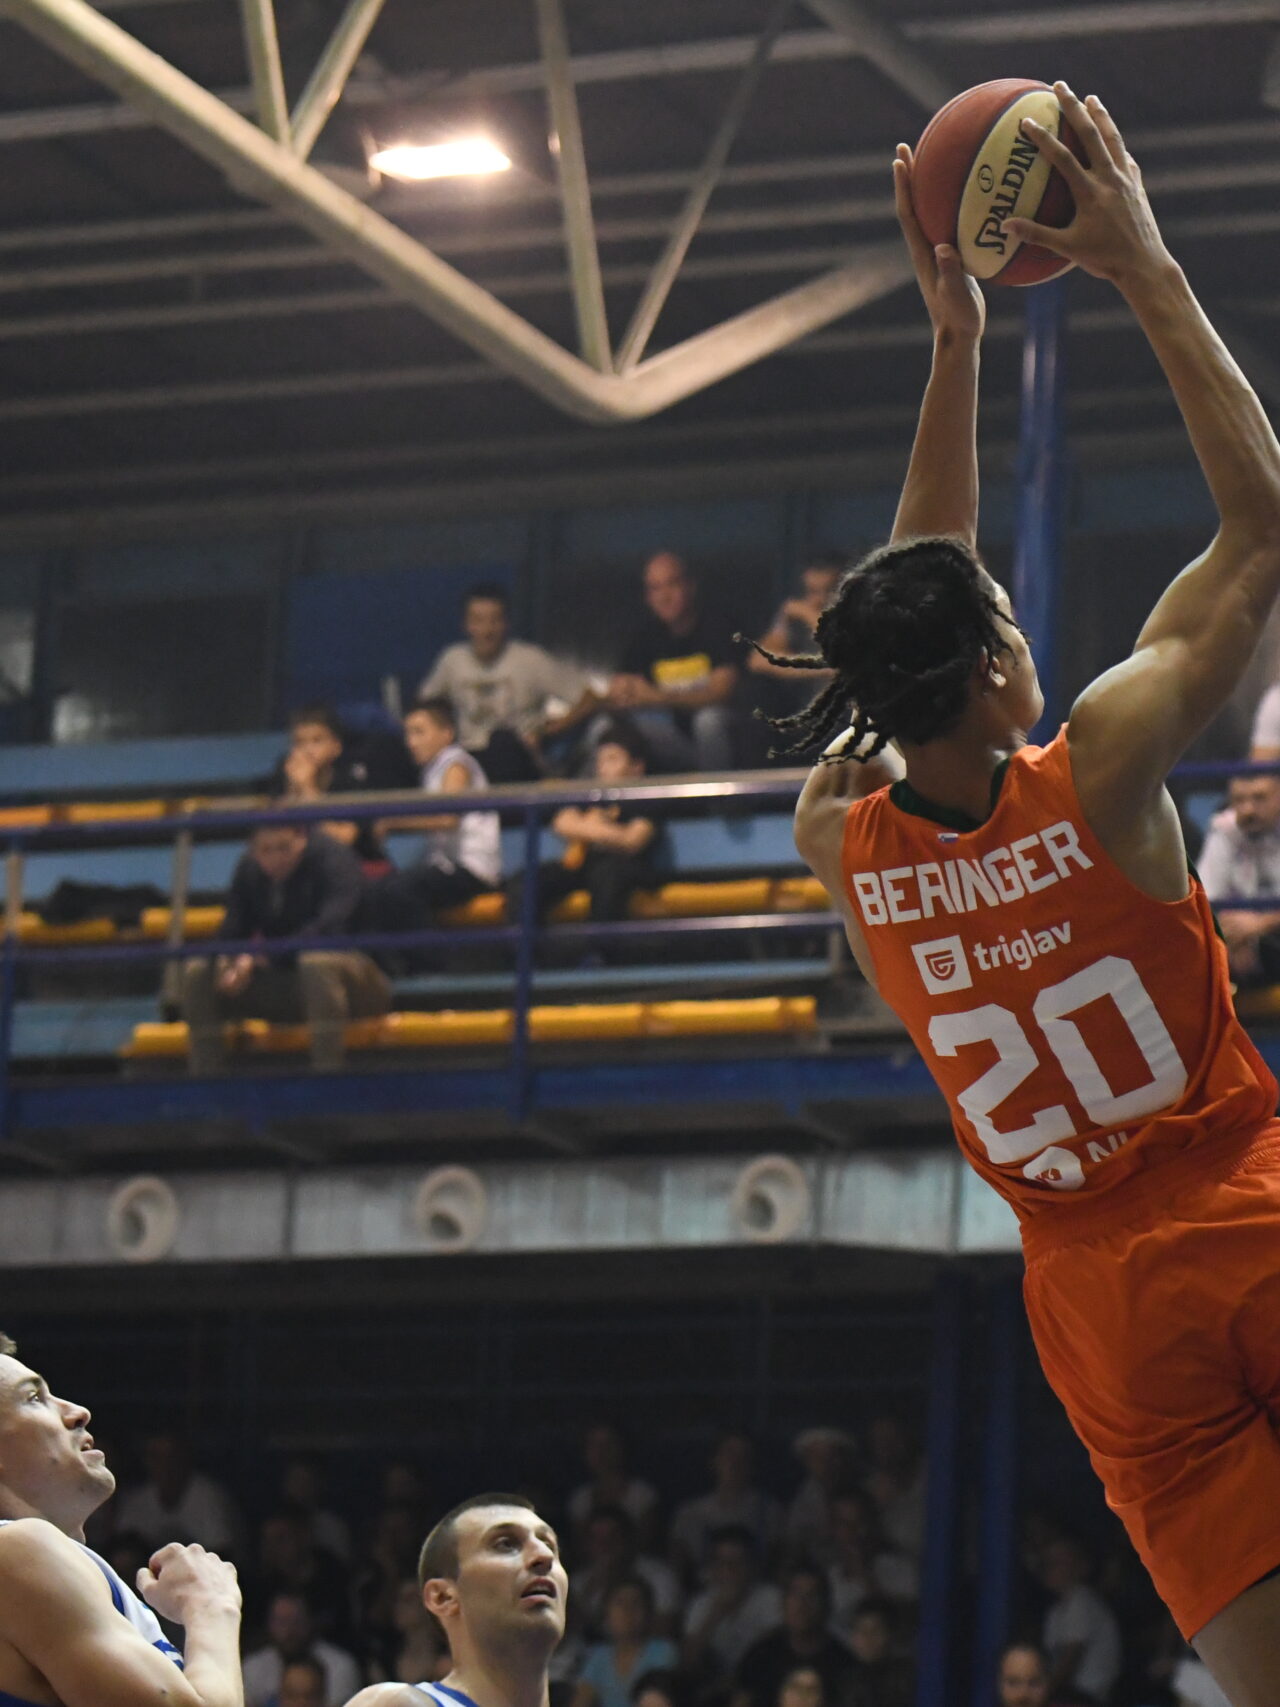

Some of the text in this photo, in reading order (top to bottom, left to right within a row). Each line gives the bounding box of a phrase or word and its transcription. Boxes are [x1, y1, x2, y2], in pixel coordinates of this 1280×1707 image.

[853, 820, 1095, 926] BERINGER
[973, 921, 1072, 971] triglav
[928, 955, 1189, 1165] 20
